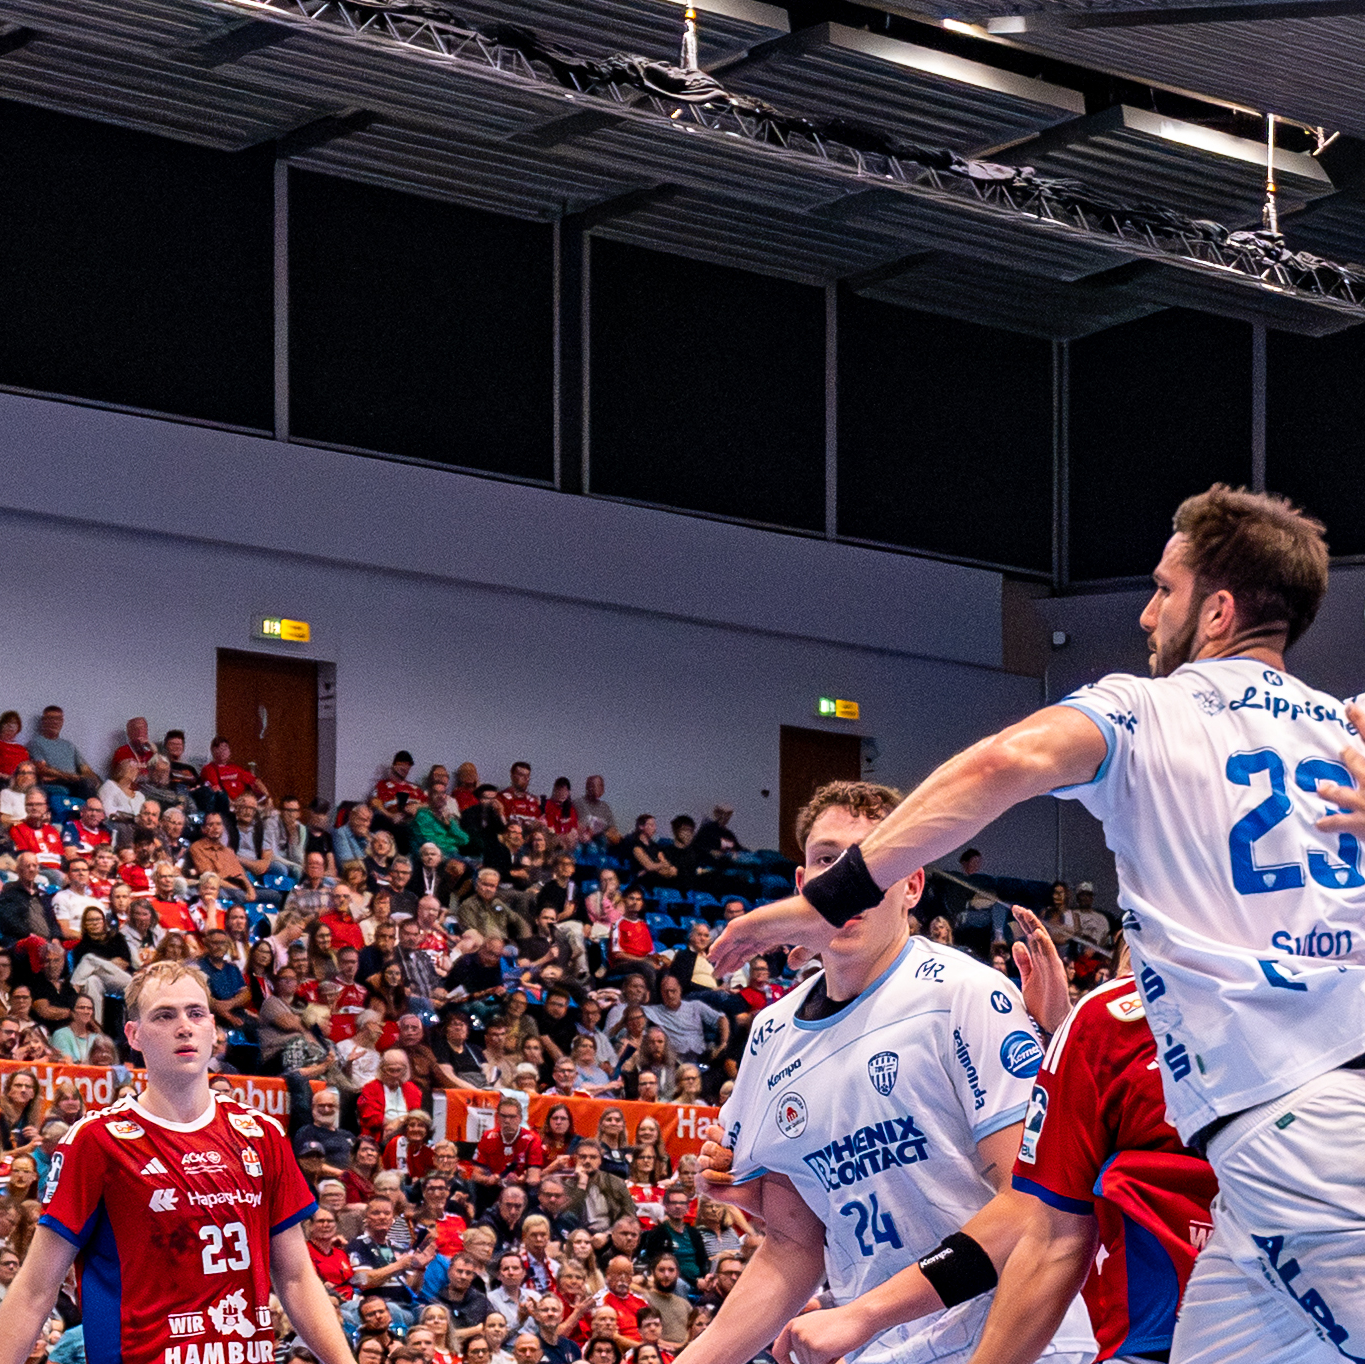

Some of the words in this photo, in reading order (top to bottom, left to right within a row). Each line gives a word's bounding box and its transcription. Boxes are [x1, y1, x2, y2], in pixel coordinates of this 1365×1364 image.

[767, 1057, 802, 1091] Kempa
[677, 1107, 717, 1141] Ha
[839, 1191, 904, 1257] 24
[198, 1222, 251, 1275] 23
[919, 1247, 955, 1269] Kempa
[169, 1315, 206, 1334] WIR
